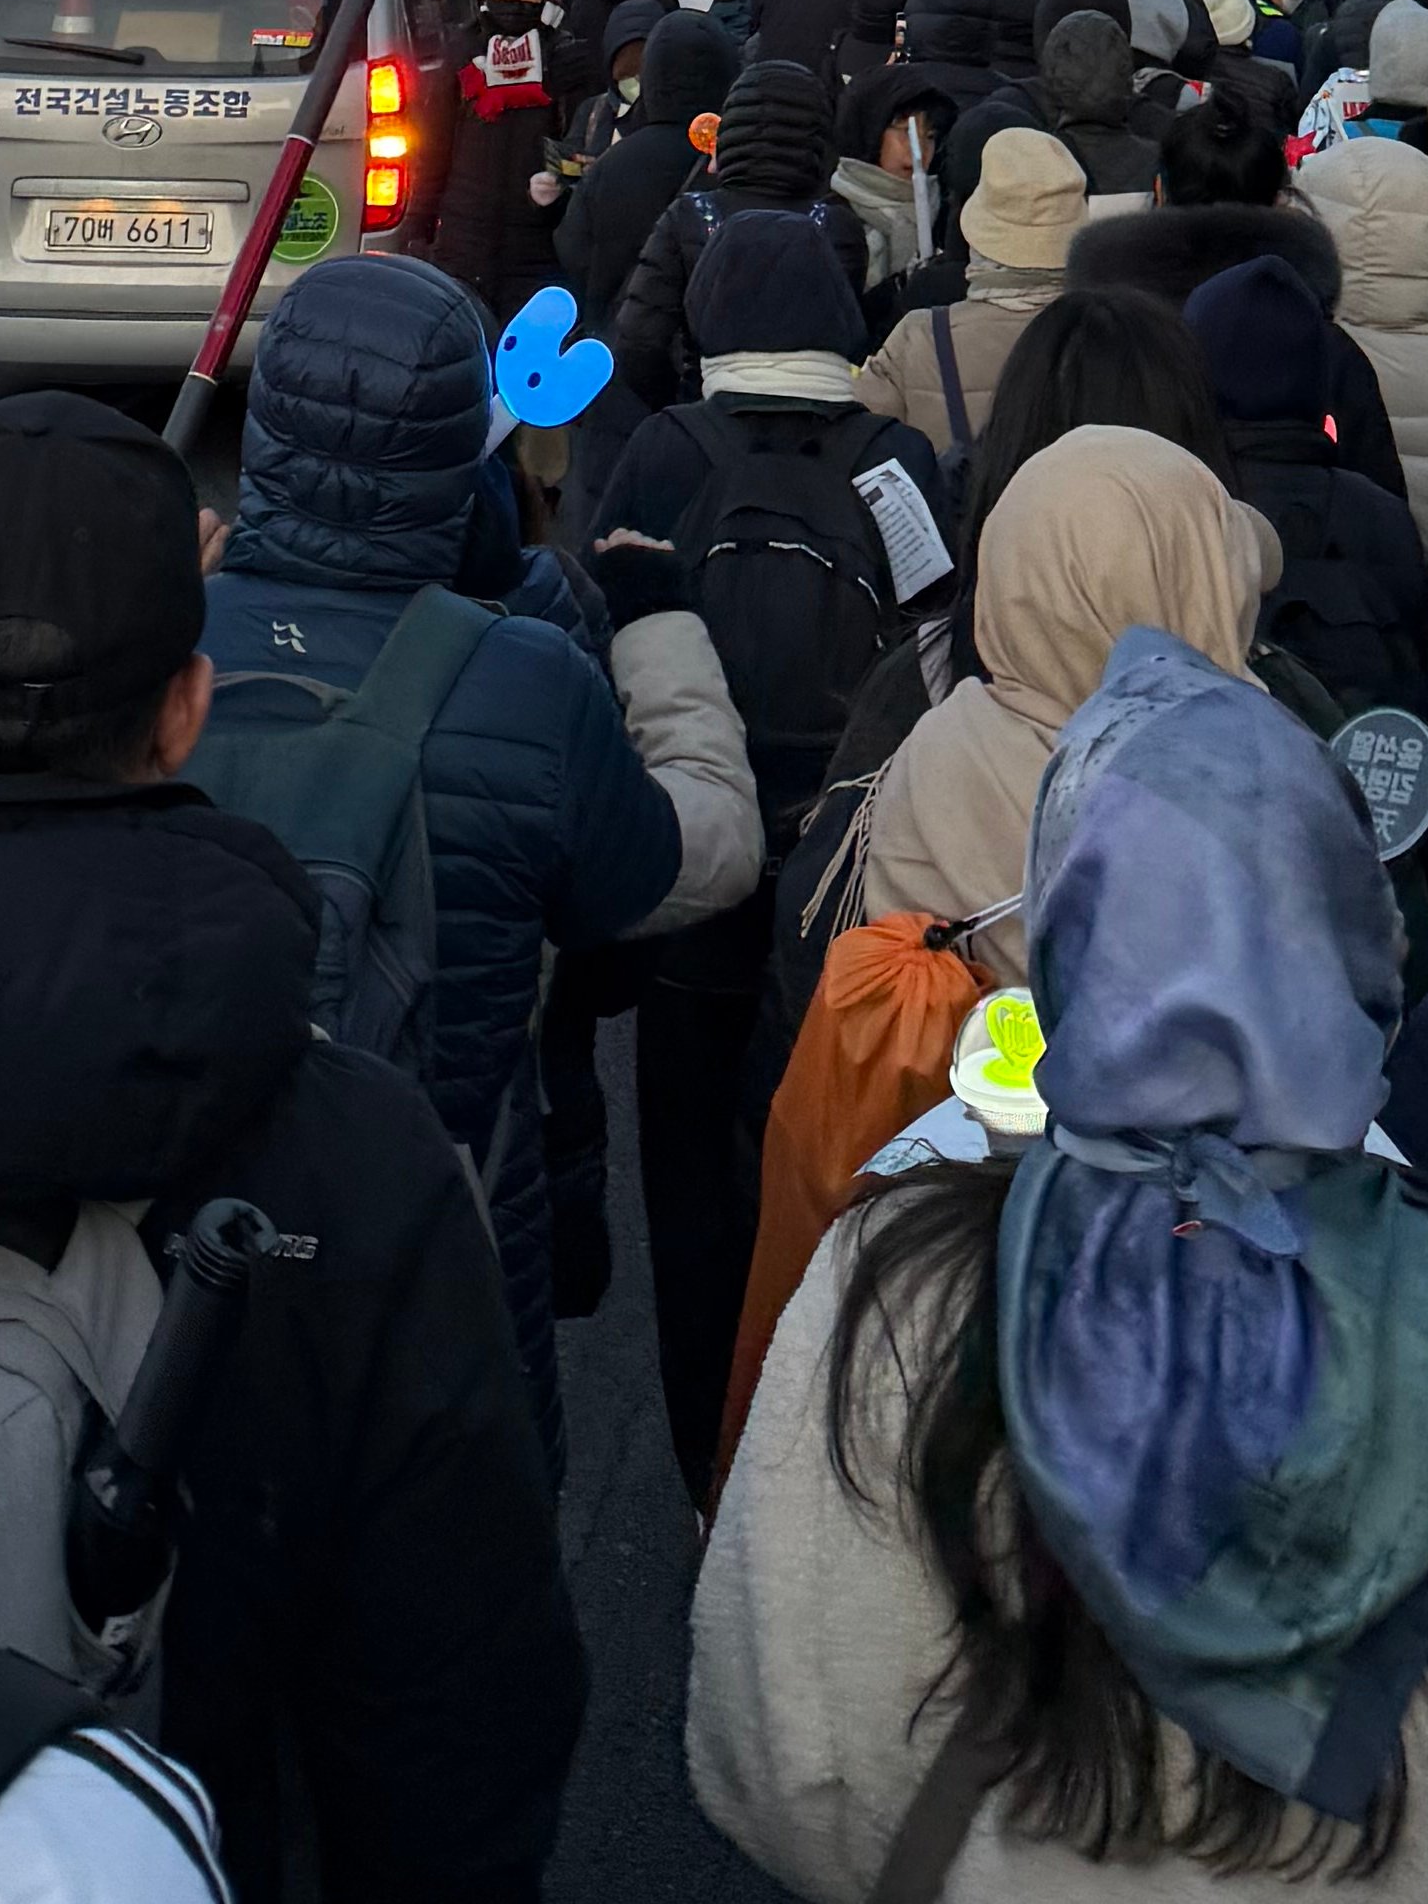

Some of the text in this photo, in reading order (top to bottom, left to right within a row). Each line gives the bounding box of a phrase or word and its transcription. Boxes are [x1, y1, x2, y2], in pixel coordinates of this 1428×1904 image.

[14, 87, 251, 119] 전국건설노동조합
[63, 215, 191, 245] 70버 6611
